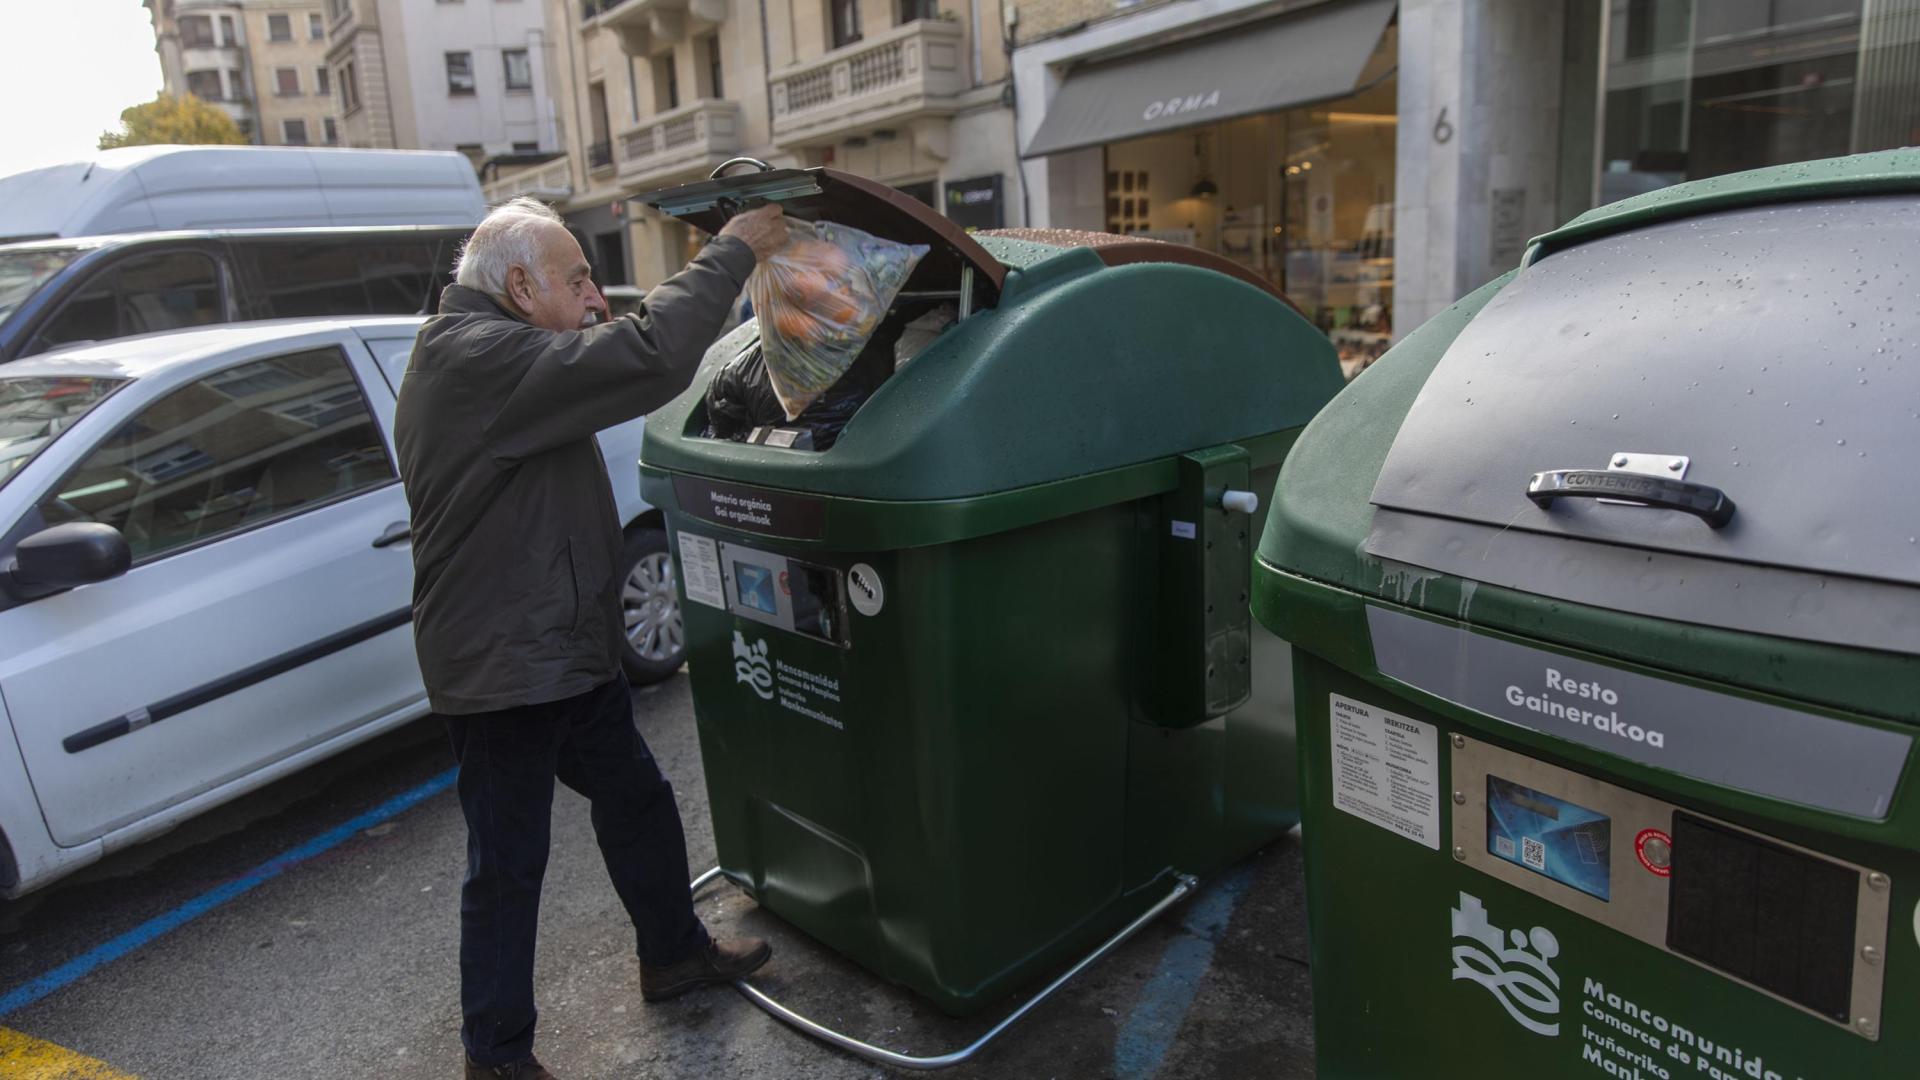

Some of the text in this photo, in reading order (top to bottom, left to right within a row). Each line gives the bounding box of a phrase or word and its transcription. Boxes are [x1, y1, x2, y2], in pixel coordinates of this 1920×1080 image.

[1143, 90, 1220, 121] ORMA
[1433, 107, 1453, 144] 6
[711, 491, 772, 512] Materia orgánica
[714, 505, 771, 526] Gai organikoak
[776, 659, 839, 691] Mancomunidad
[1546, 667, 1618, 706] Resto
[1335, 701, 1369, 718] APERTURA
[1384, 716, 1420, 735] IREKITZEA
[1505, 685, 1664, 748] Gainerakoa
[1582, 1001, 1661, 1050] Comarca
[1667, 1043, 1691, 1065] de
[1582, 1024, 1670, 1080] Iruñerriko
